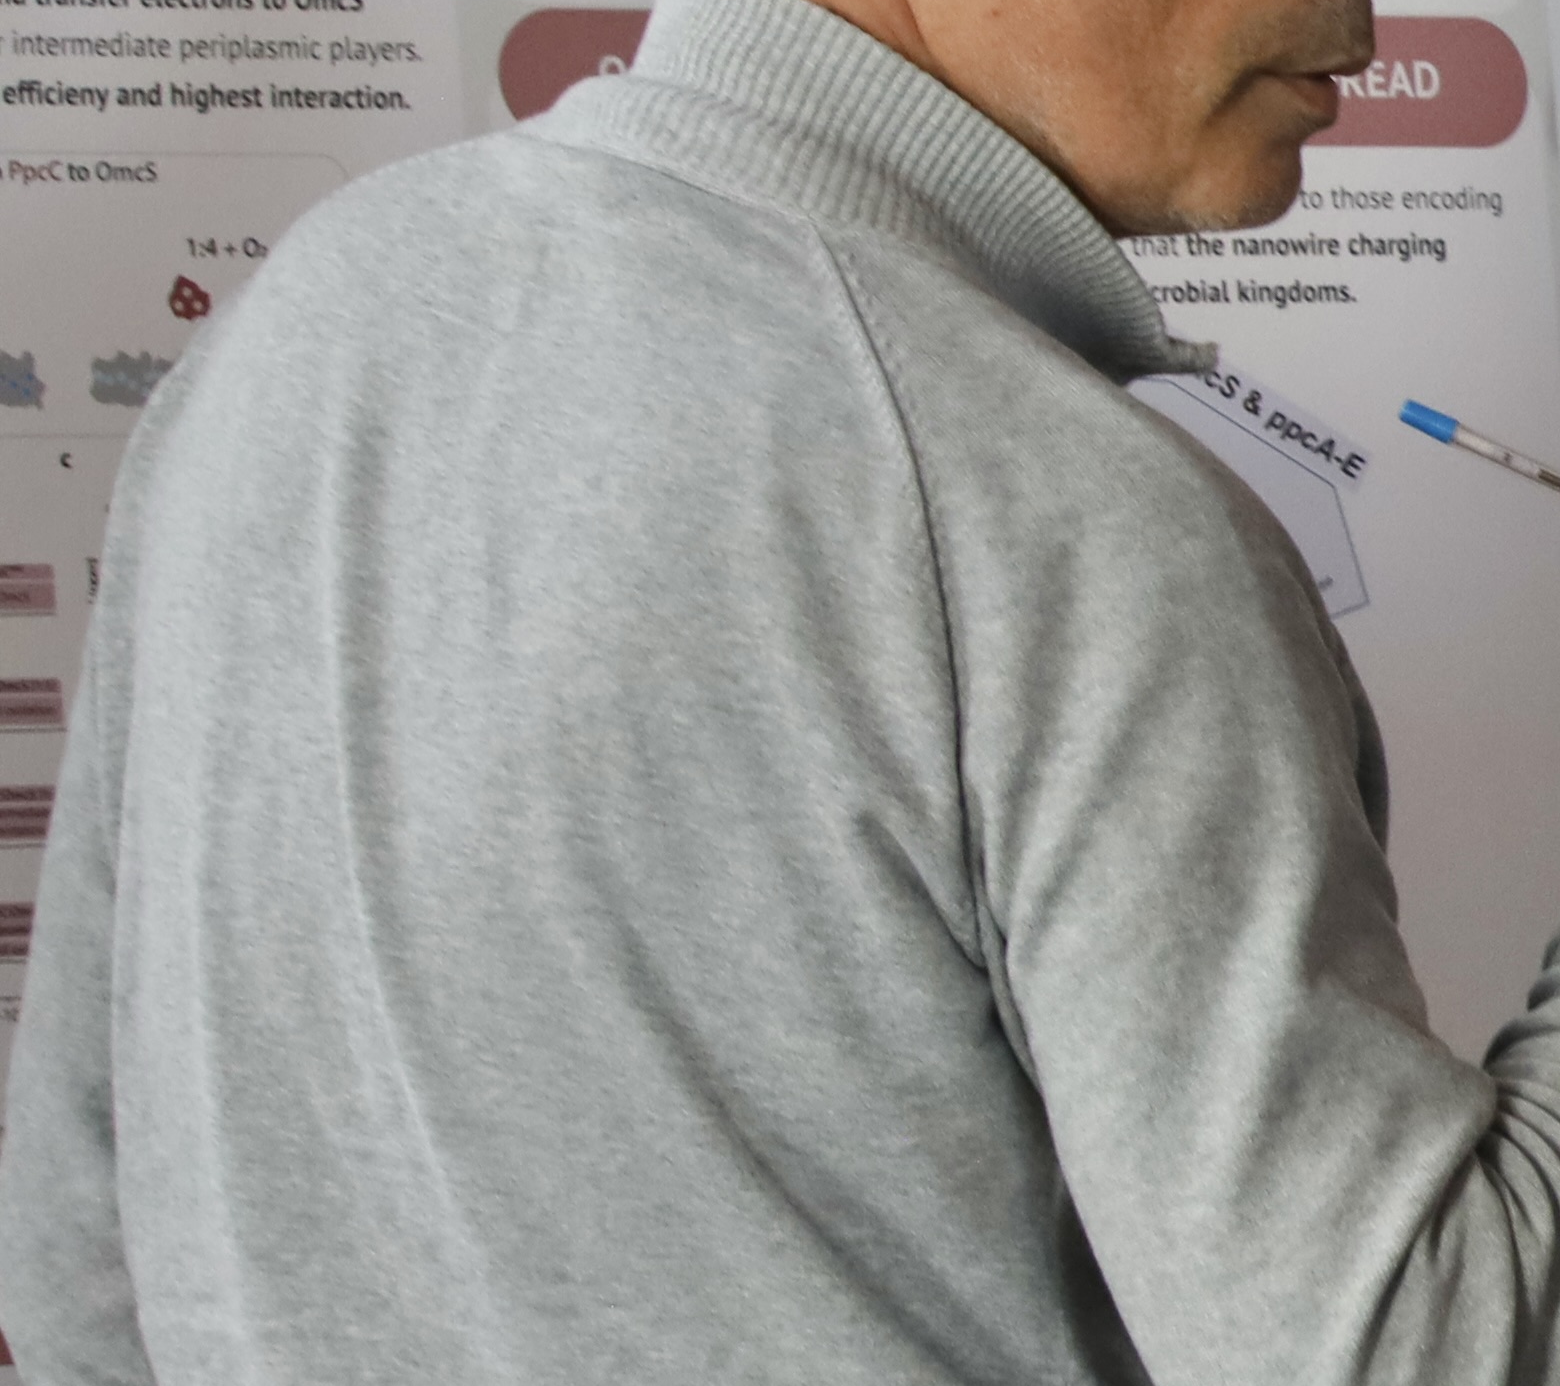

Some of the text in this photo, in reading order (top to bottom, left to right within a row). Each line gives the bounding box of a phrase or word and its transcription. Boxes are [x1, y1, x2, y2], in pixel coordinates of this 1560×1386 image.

[13, 30, 422, 67] intermediate periplasmic players.
[116, 83, 162, 107] and
[170, 82, 263, 114] highest
[271, 84, 410, 110] interaction.
[8, 160, 158, 185] PpcC to OmcS
[1330, 187, 1394, 210] those
[1401, 187, 1503, 218] encoding
[1186, 233, 1224, 256] the
[1233, 232, 1340, 256] nanowire
[1348, 233, 1447, 262] charging
[1237, 280, 1356, 309] kingdoms.
[1243, 390, 1263, 416] &
[1265, 410, 1367, 480] ppcA-E
